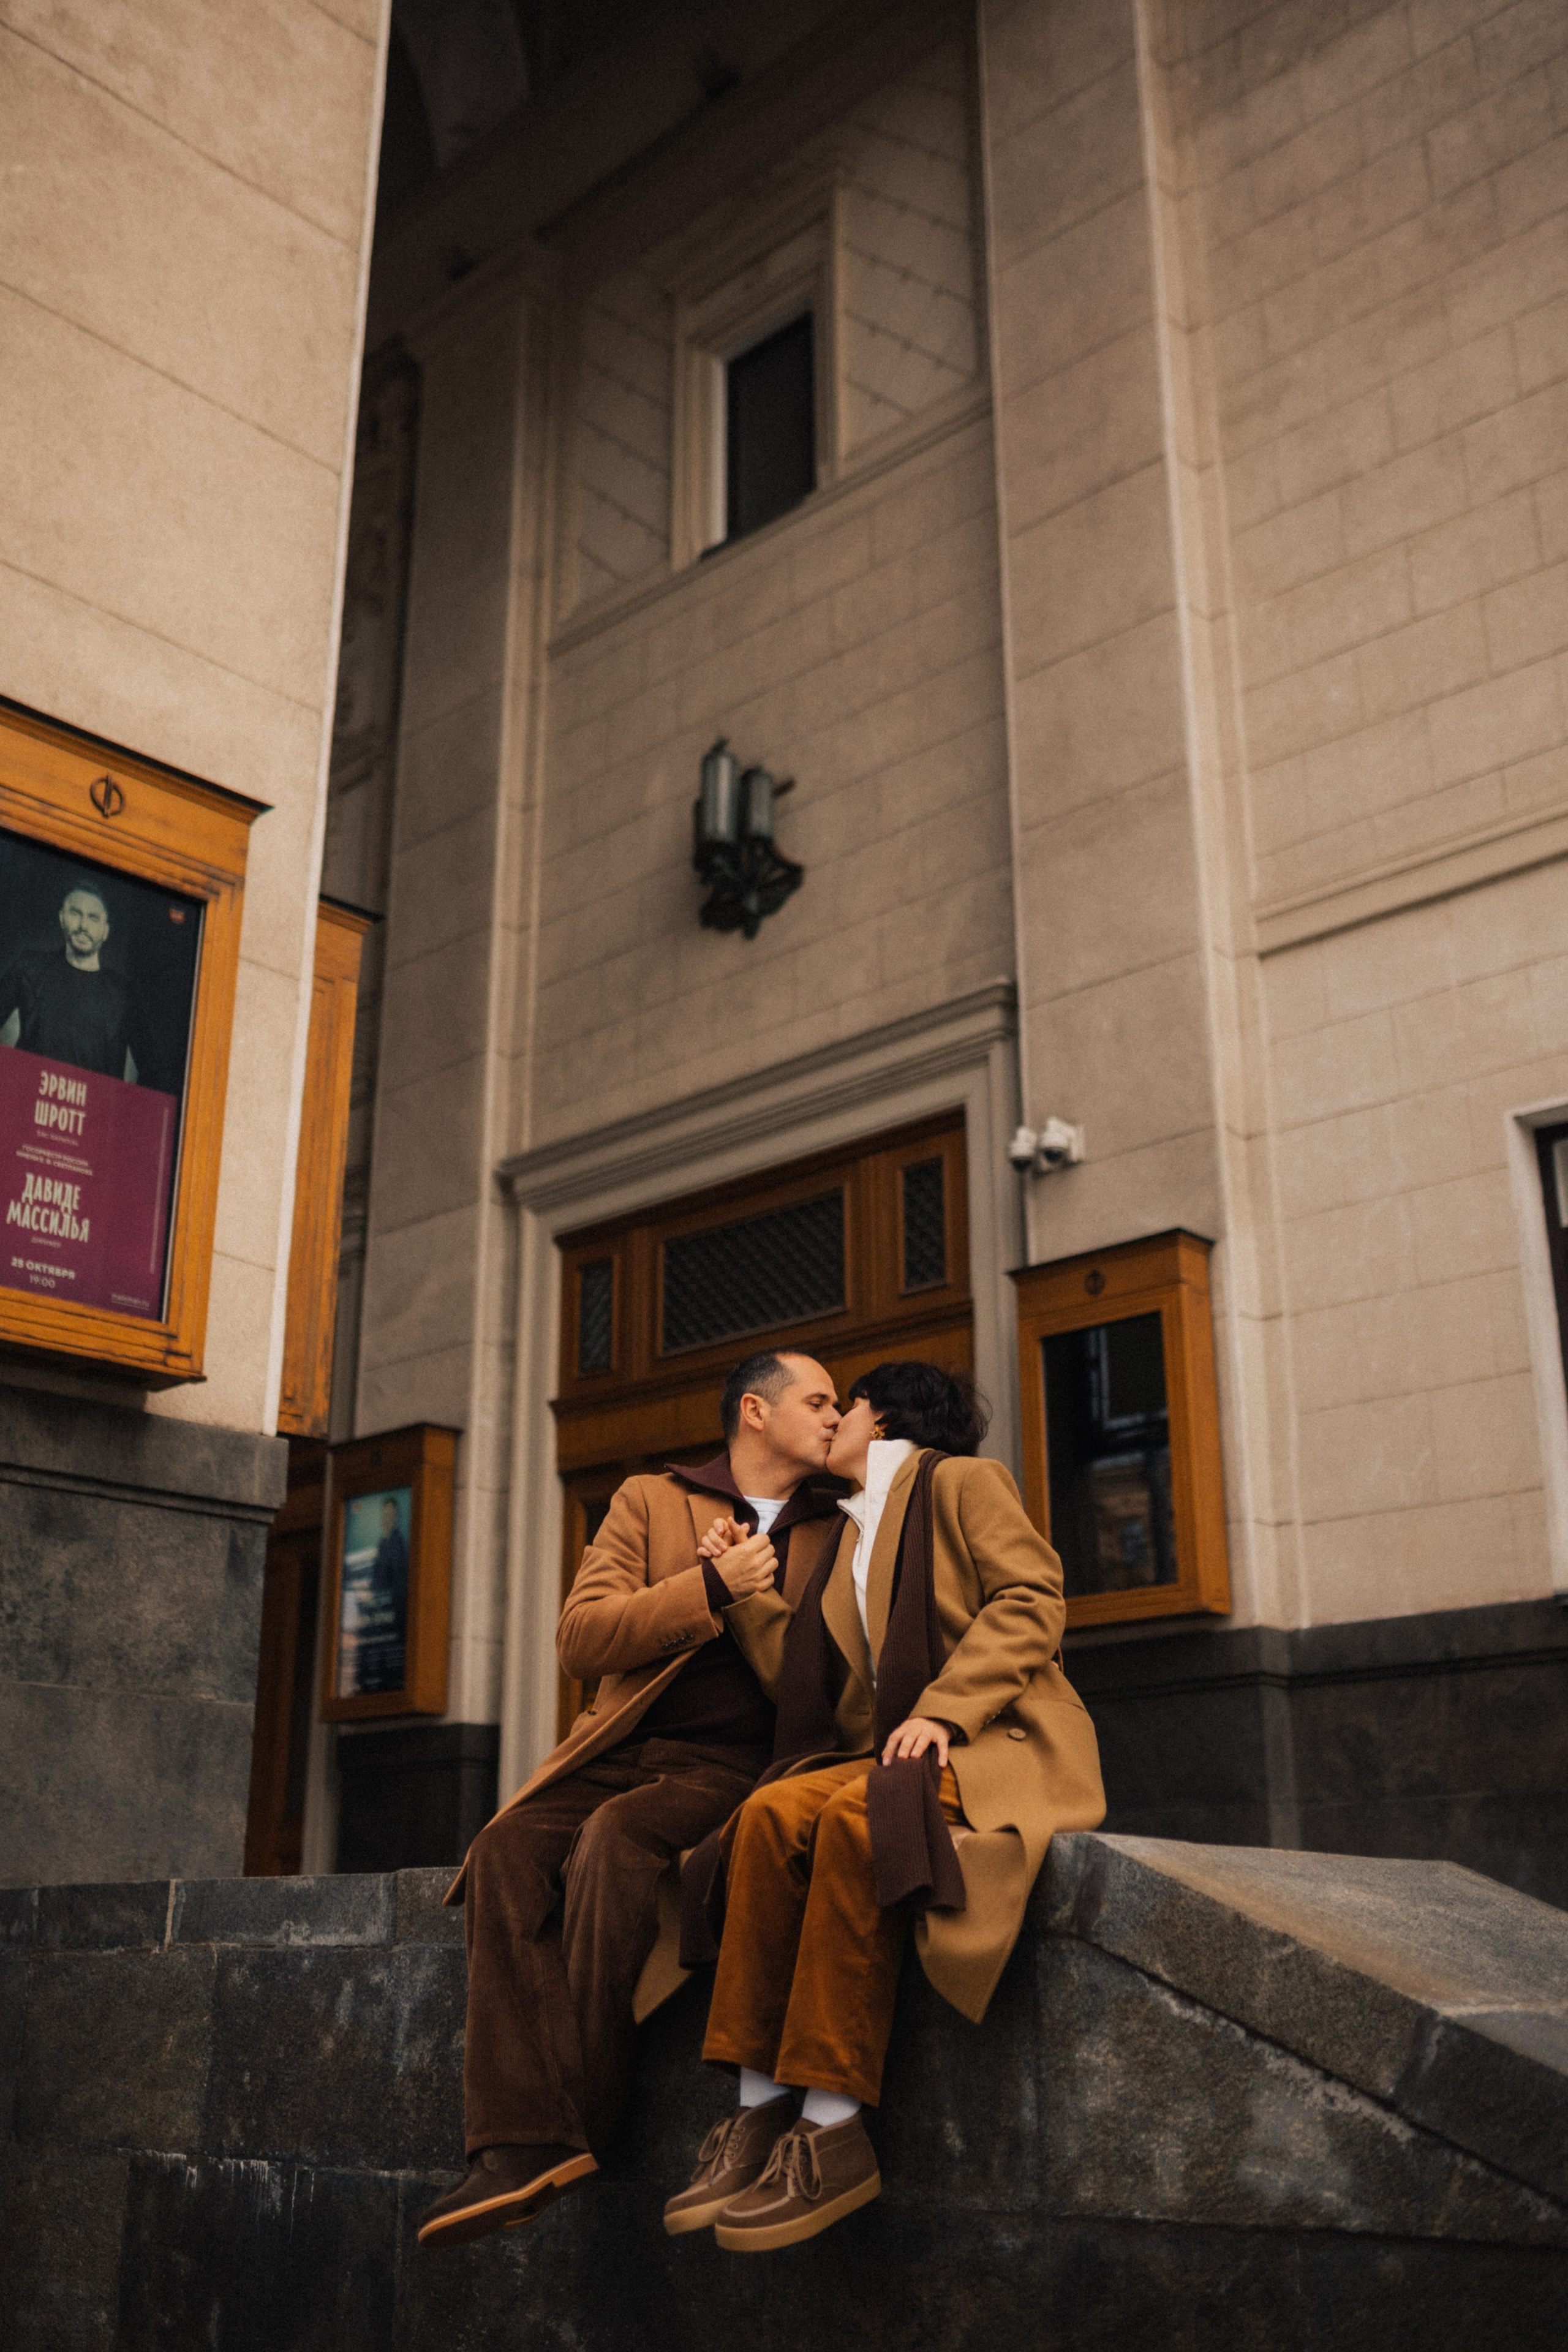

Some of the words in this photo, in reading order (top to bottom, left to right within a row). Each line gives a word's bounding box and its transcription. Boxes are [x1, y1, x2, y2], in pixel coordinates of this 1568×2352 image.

[39, 1070, 87, 1107] ЭРВИН
[34, 1099, 85, 1136] ШРОТТ
[21, 1172, 80, 1215] ДАВИДЕ
[7, 1199, 89, 1243] МАССИЛЬЯ
[26, 1260, 75, 1280] ОКТЯБРЯ
[29, 1274, 56, 1289] 19:00
